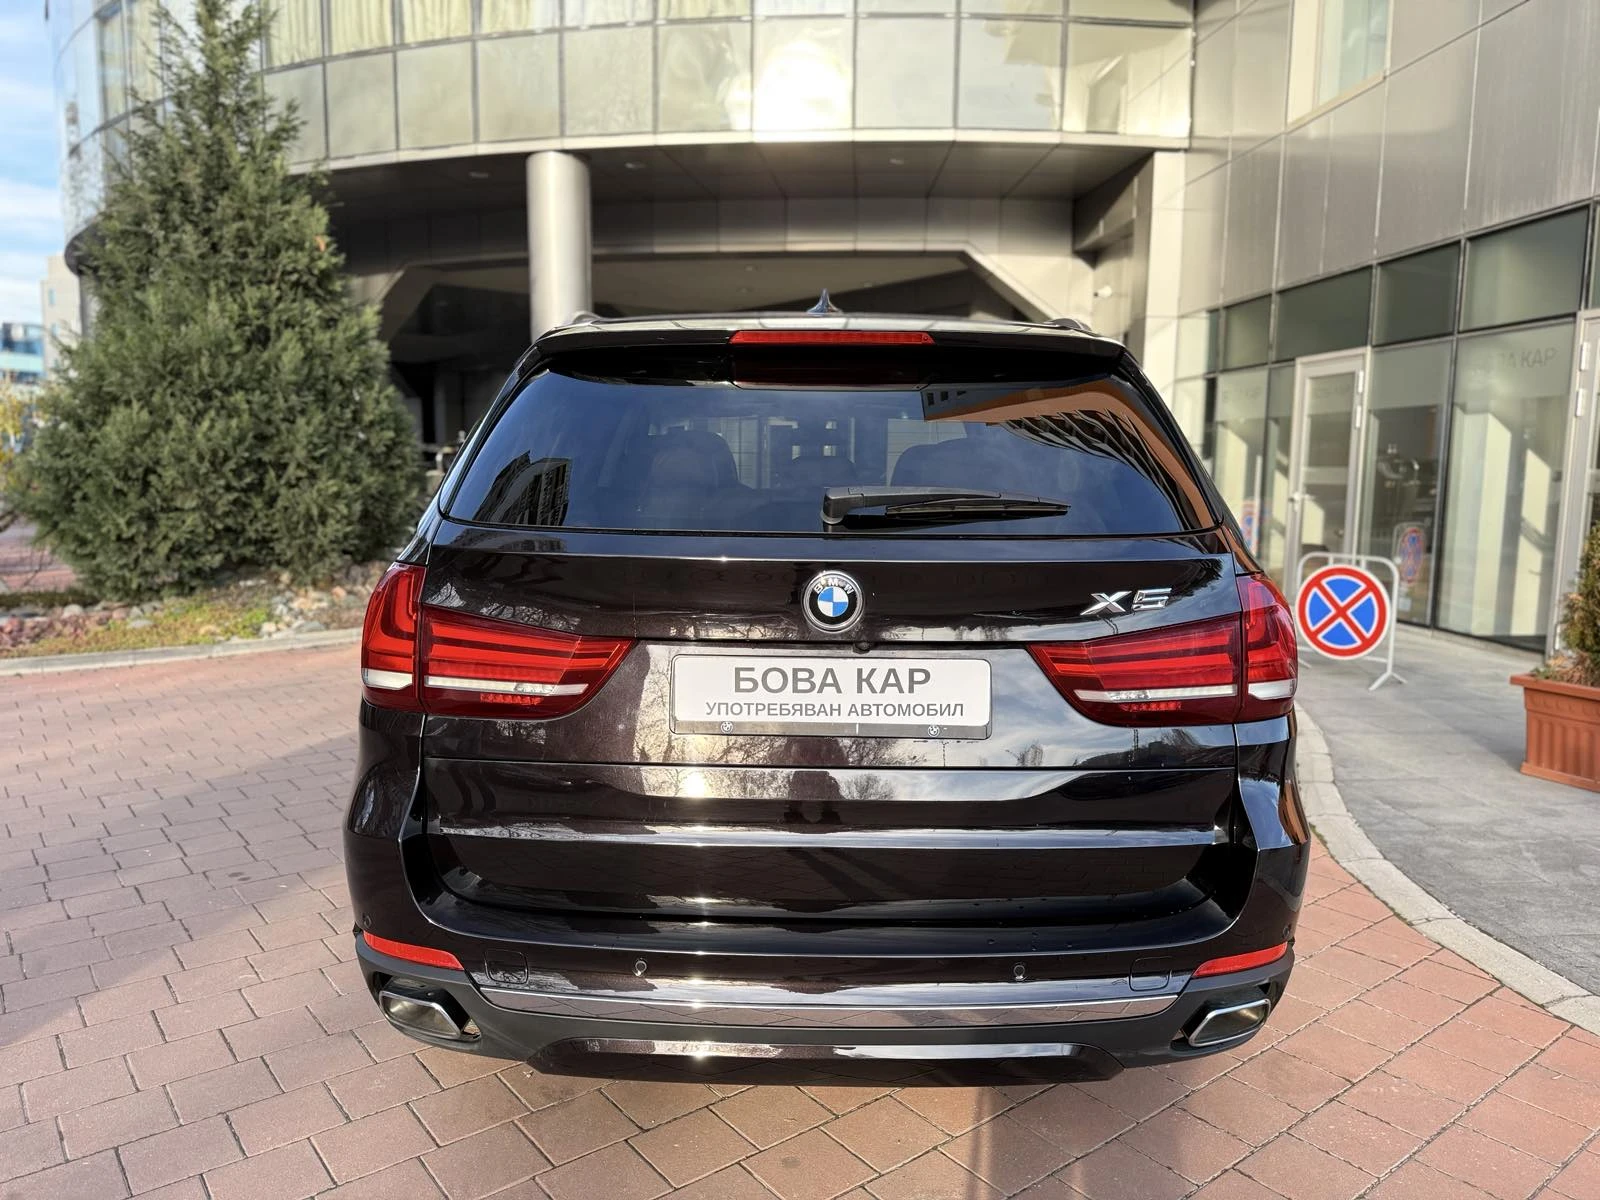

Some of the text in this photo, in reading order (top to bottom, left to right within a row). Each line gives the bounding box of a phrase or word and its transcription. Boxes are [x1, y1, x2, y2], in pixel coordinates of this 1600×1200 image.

[813, 577, 855, 595] BMW
[1080, 587, 1172, 616] X5
[734, 666, 931, 694] БОВА КАР
[706, 702, 964, 717] УПОТРЕБЯВАН АВТОМОБИЛ
